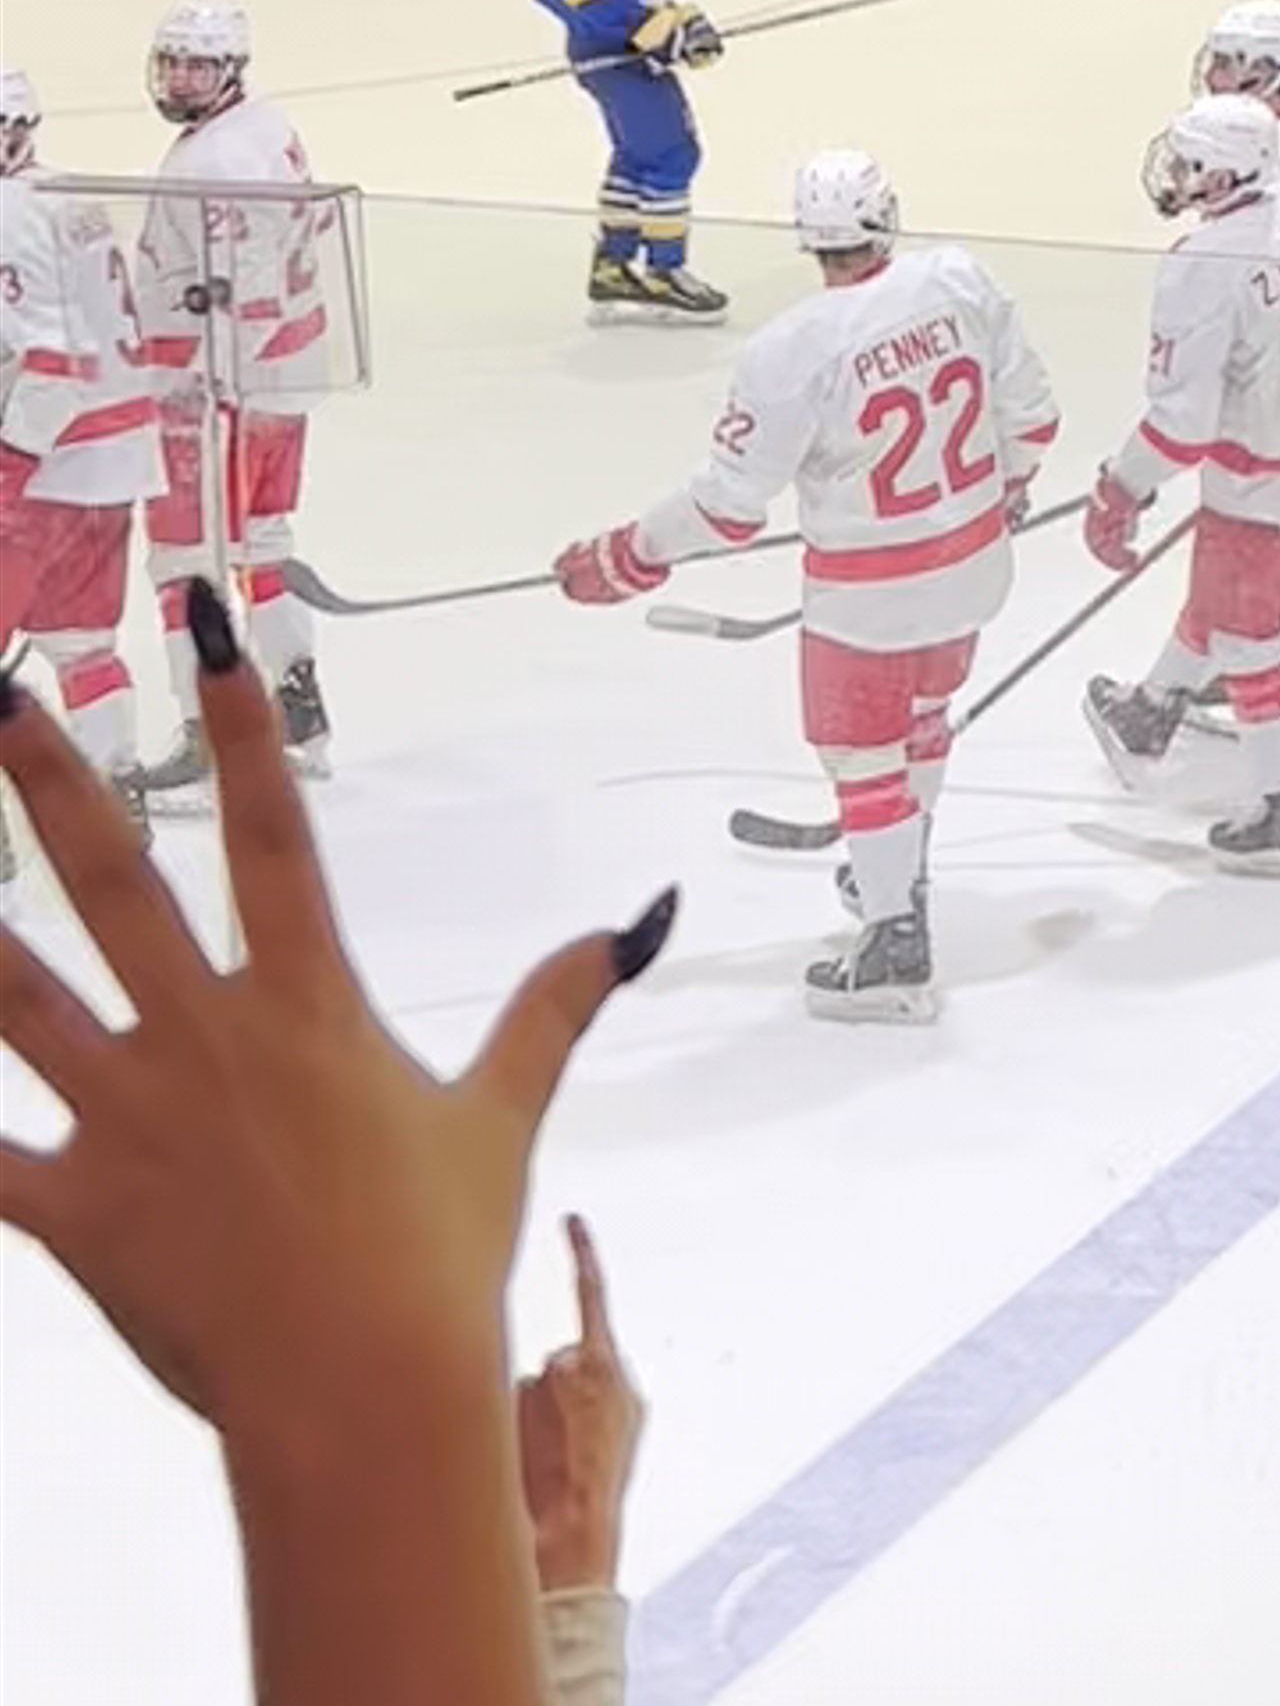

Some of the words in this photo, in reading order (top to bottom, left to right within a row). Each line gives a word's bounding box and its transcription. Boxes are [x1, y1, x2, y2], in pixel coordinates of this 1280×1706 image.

[853, 313, 962, 388] PENNEY
[712, 400, 757, 456] 22
[857, 355, 997, 521] 22
